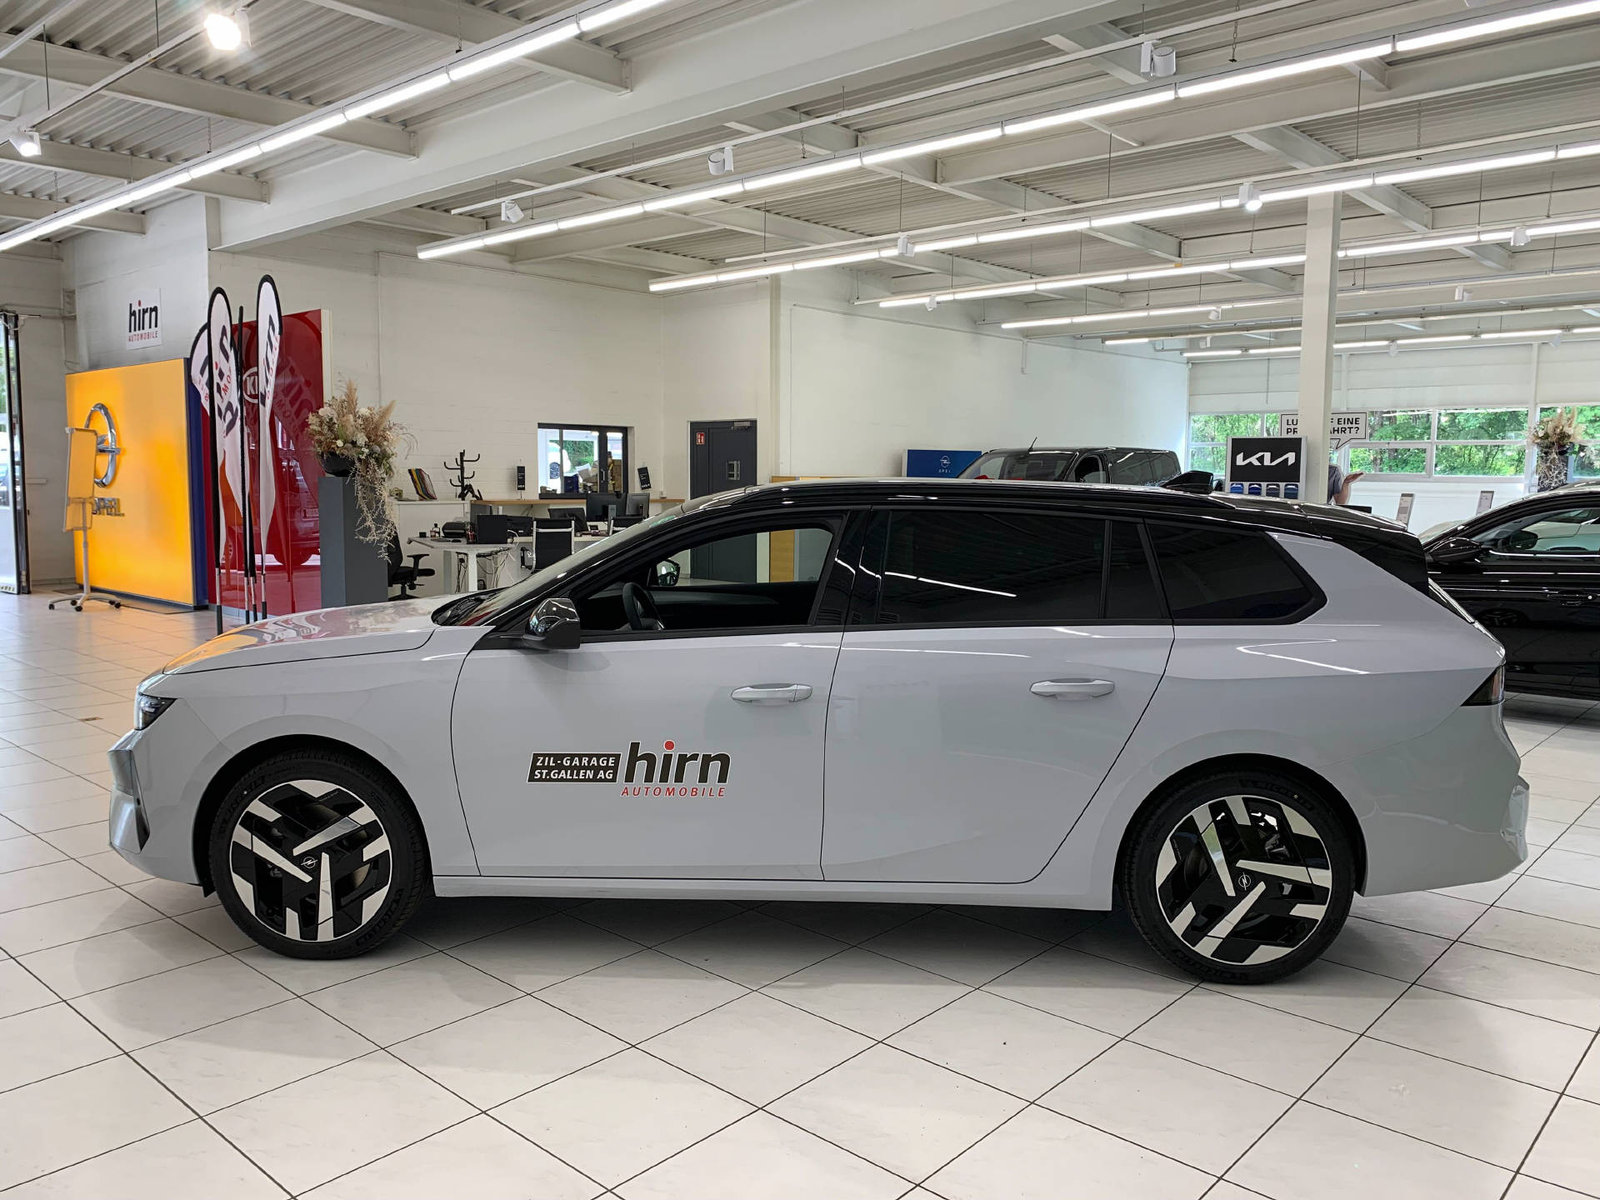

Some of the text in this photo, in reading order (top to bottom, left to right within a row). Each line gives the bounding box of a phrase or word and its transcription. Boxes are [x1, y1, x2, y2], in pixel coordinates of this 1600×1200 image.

[128, 299, 158, 333] hirn
[246, 375, 258, 395] KI
[1337, 417, 1360, 425] EINE
[1236, 451, 1296, 466] KIA
[536, 756, 616, 767] ZIL-GARAGE
[624, 740, 731, 784] hirn
[533, 769, 614, 779] ST.GALLEN AG
[620, 786, 726, 798] AUTOMOBILE
